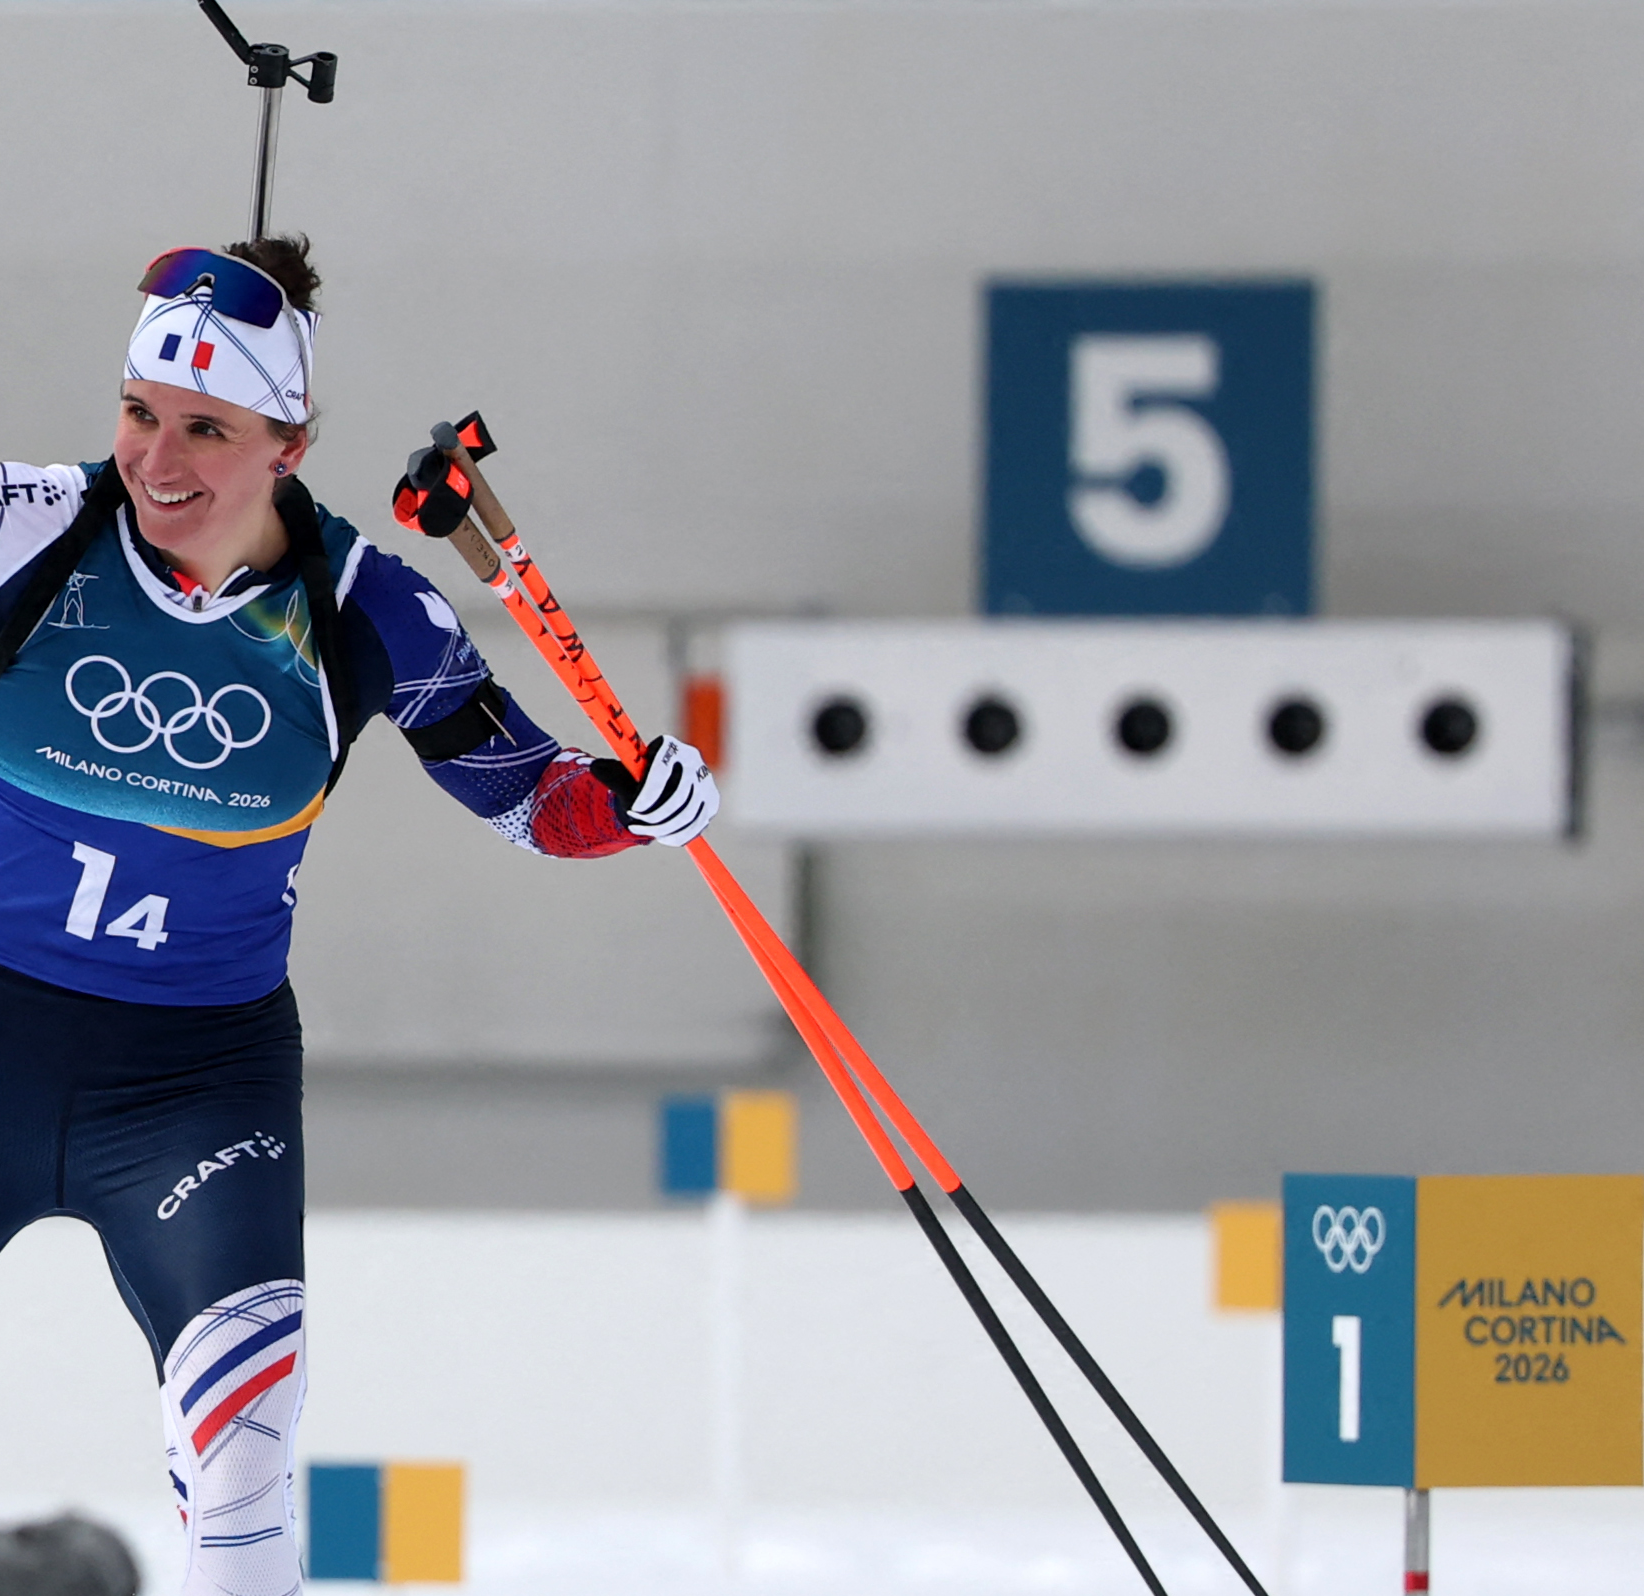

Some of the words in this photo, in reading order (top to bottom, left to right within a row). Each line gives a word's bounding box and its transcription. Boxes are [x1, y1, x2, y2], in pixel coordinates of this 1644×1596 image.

[1067, 330, 1233, 571] 5
[35, 746, 123, 782] MILANO
[125, 772, 223, 804] CORTINA
[227, 792, 271, 808] 2026
[156, 1139, 261, 1221] CRAFT
[1438, 1277, 1596, 1309] MILANO
[1464, 1314, 1627, 1346] CORTINA
[1331, 1315, 1361, 1442] 1
[1494, 1352, 1570, 1384] 2026
